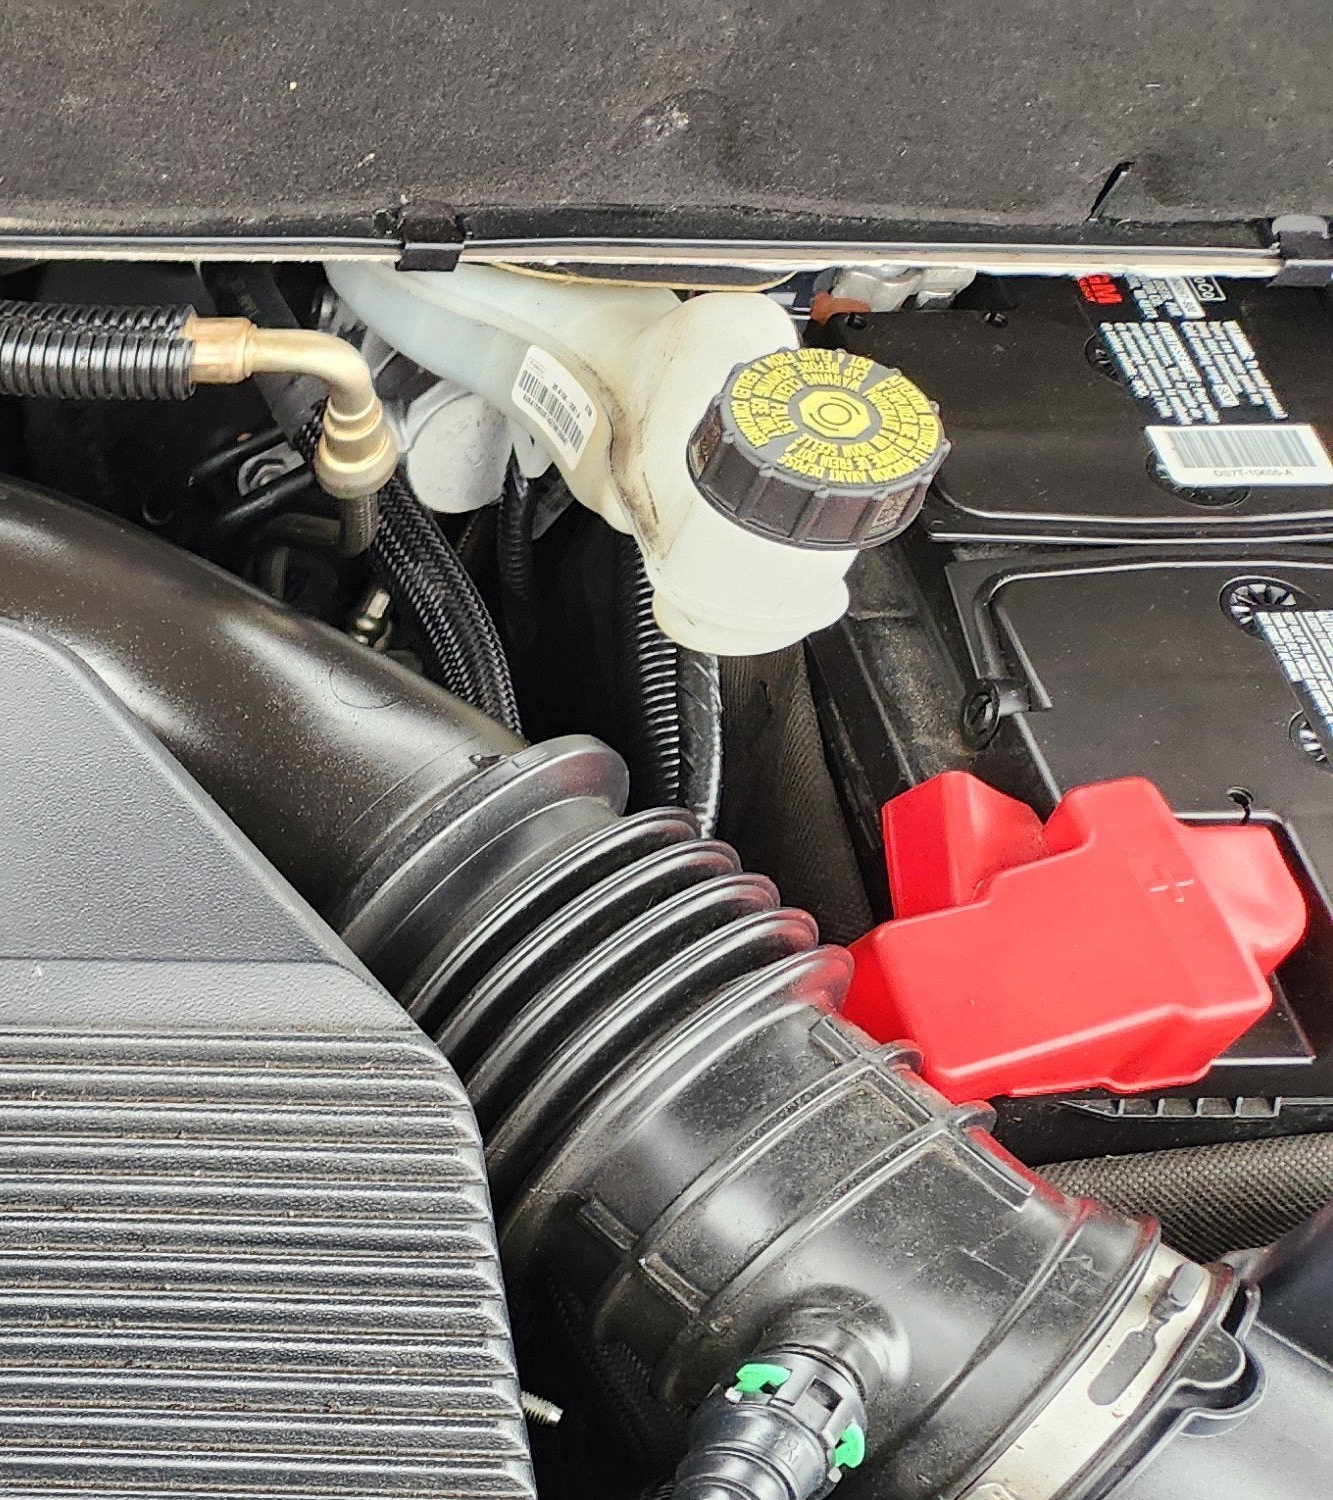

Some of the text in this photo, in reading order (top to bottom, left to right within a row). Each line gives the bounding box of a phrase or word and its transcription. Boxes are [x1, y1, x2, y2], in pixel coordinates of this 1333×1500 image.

[763, 352, 798, 371] FROM
[796, 348, 833, 364] FLUID
[791, 359, 841, 376] BEFORE
[842, 365, 869, 382] CAP
[801, 372, 862, 391] WARNING
[817, 453, 856, 471] FREIN
[828, 468, 869, 484] AVANT
